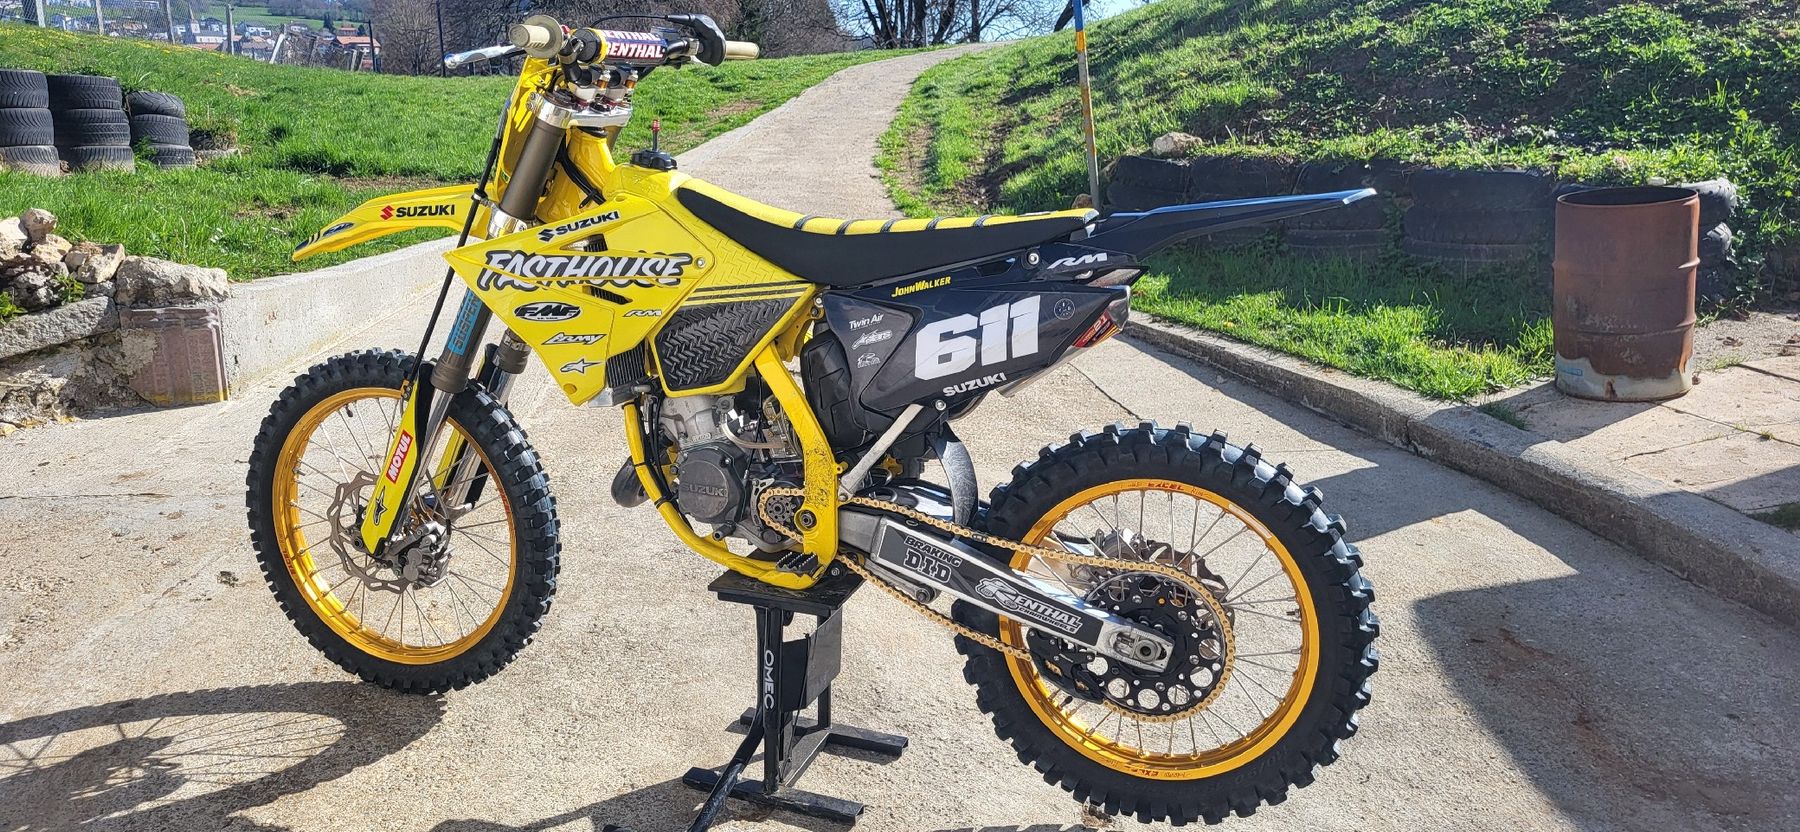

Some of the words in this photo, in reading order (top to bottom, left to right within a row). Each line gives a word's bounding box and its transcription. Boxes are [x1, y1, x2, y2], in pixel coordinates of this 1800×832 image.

[395, 204, 455, 218] SUZUKI
[556, 210, 620, 236] SUZUKI
[477, 249, 693, 293] FASTHOUSE
[1046, 252, 1108, 270] RM
[514, 305, 581, 318] FMF
[623, 309, 662, 318] RM
[849, 317, 870, 330] Twin
[870, 312, 884, 324] Air
[914, 294, 1041, 381] 611
[942, 372, 1007, 397] SUZUKI
[387, 433, 411, 482] MOTUL
[681, 481, 729, 498] SUZUKI
[904, 535, 963, 568] BRAKING
[1019, 607, 1077, 633] CHAINWHEELS
[764, 649, 775, 710] OMEC
